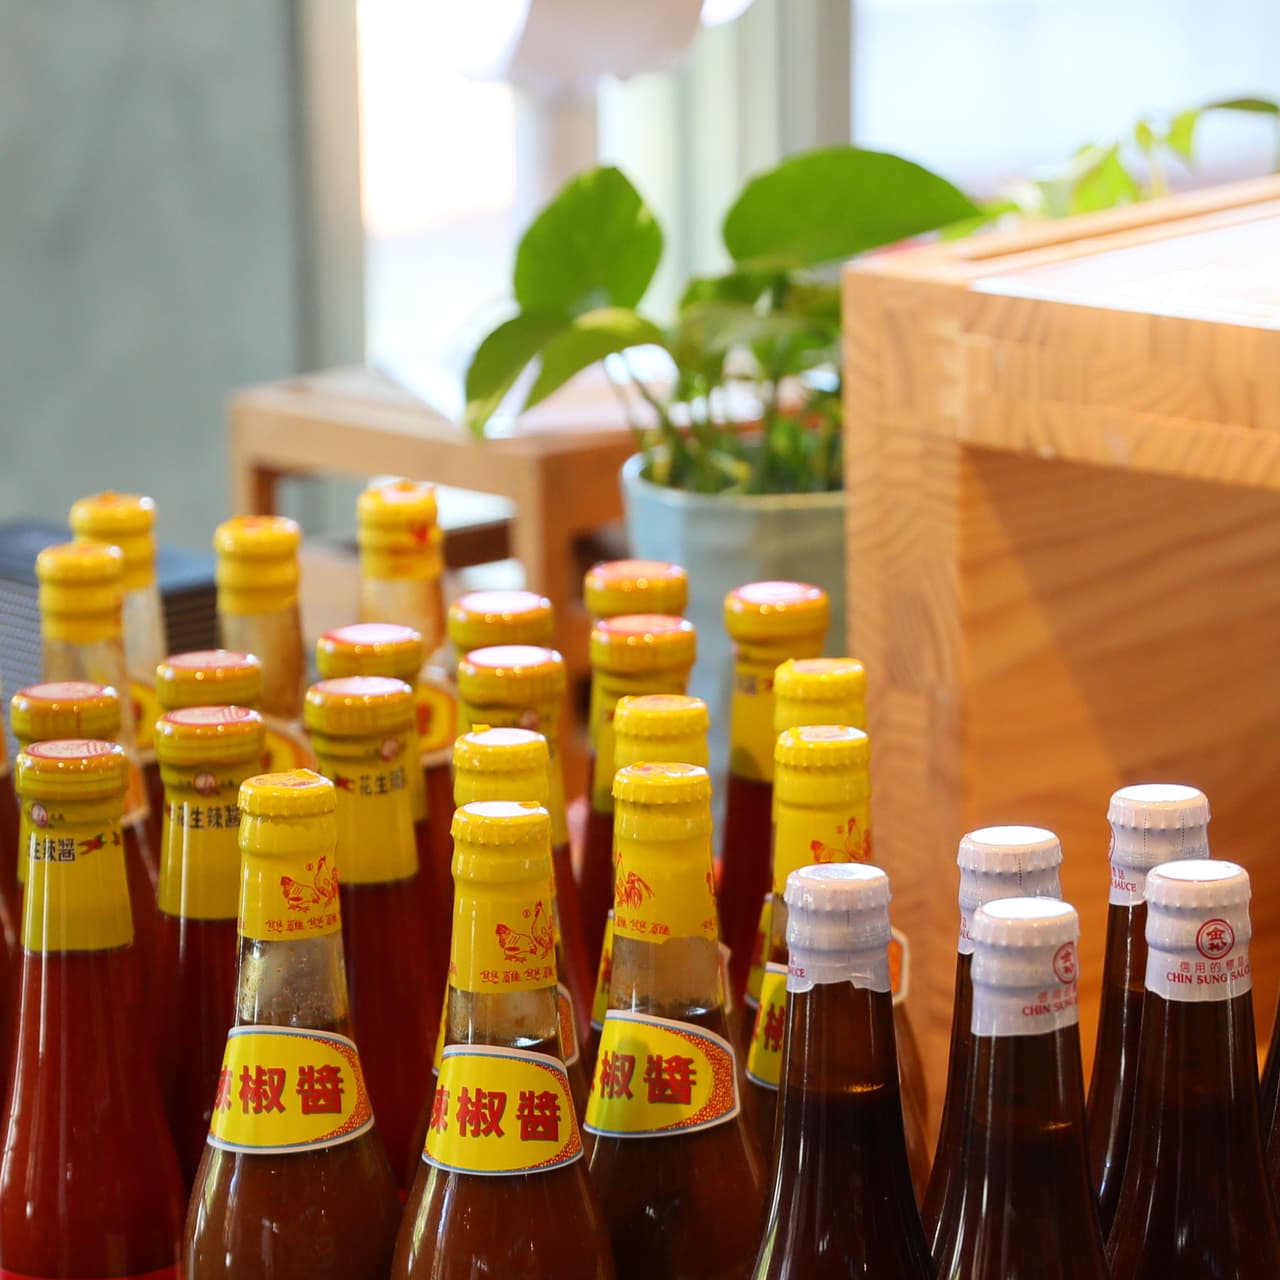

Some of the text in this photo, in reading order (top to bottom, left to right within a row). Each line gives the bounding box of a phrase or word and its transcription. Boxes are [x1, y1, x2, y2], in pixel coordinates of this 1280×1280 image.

[1114, 881, 1137, 893] SAUCE
[1166, 971, 1194, 984] CHIN
[1196, 973, 1229, 985] SUNG
[1022, 1004, 1051, 1017] CHIN
